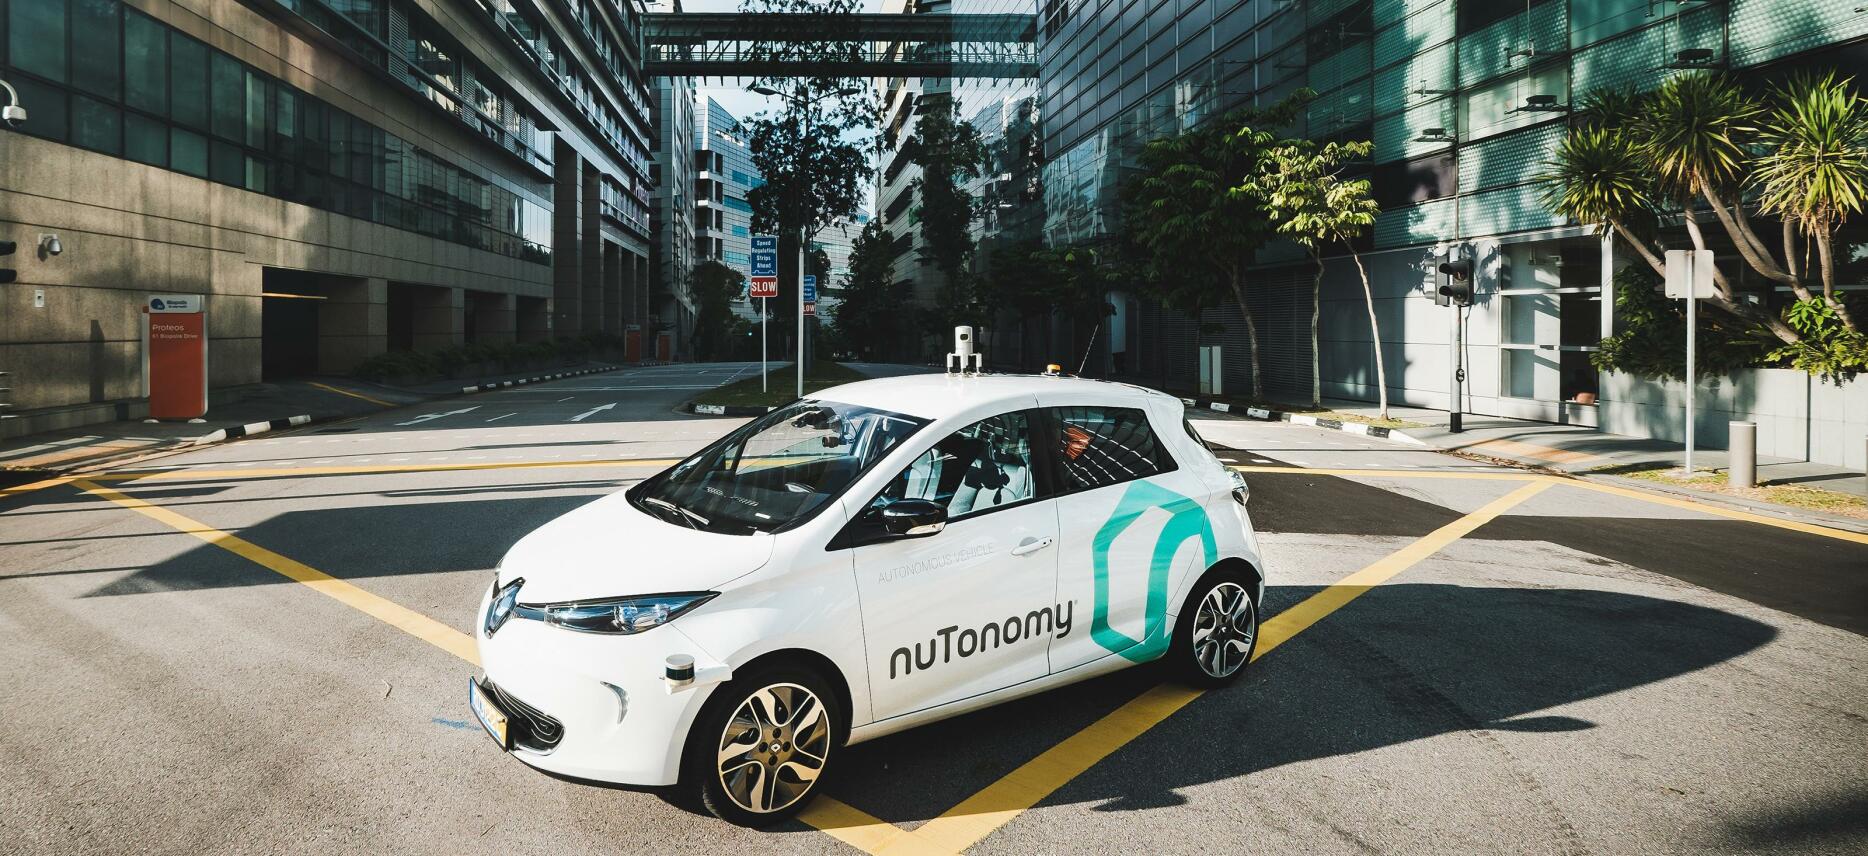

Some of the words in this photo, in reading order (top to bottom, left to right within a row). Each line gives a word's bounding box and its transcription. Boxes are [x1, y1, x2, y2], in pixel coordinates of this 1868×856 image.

[751, 281, 776, 292] SLOW
[878, 553, 953, 584] AUTONOMOUS
[953, 542, 993, 562] VEHICLE
[890, 600, 1073, 680] nuTonomy
